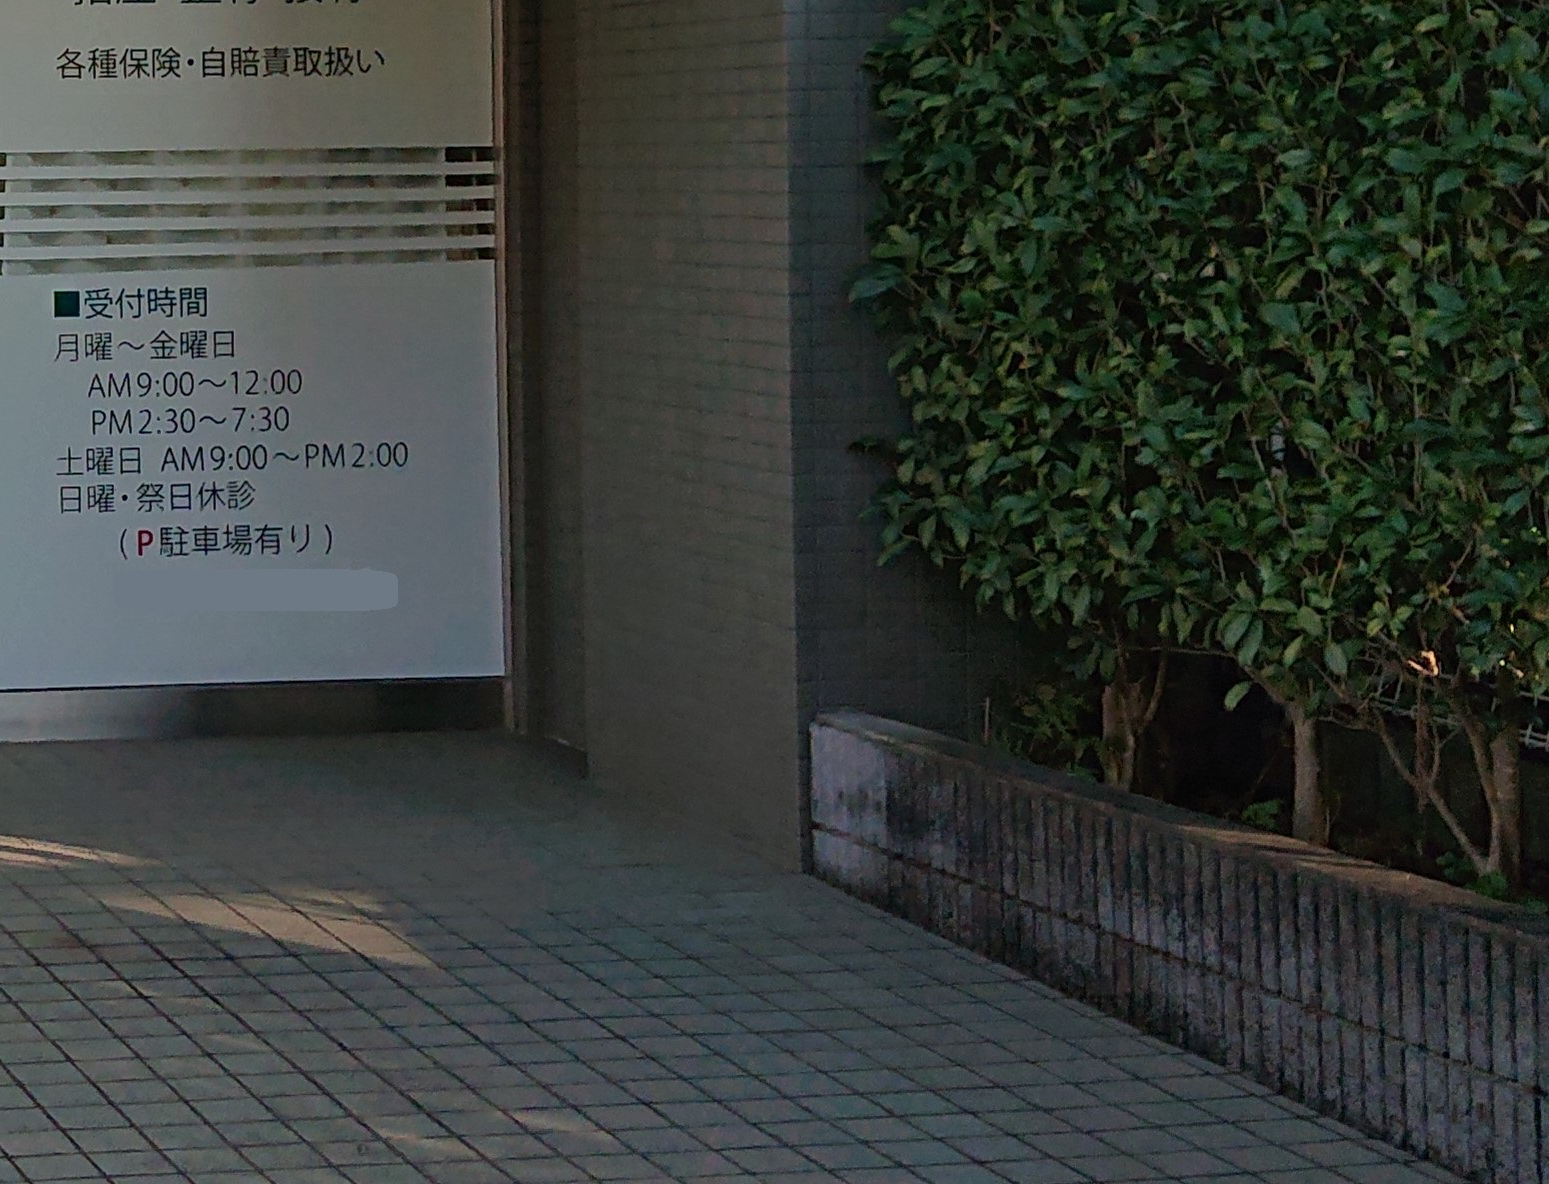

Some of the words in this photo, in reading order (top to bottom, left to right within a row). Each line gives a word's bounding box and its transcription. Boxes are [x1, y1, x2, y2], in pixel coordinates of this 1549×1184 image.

[55, 446, 142, 476] 土曜日
[59, 481, 256, 514] 日曜・祭日休診
